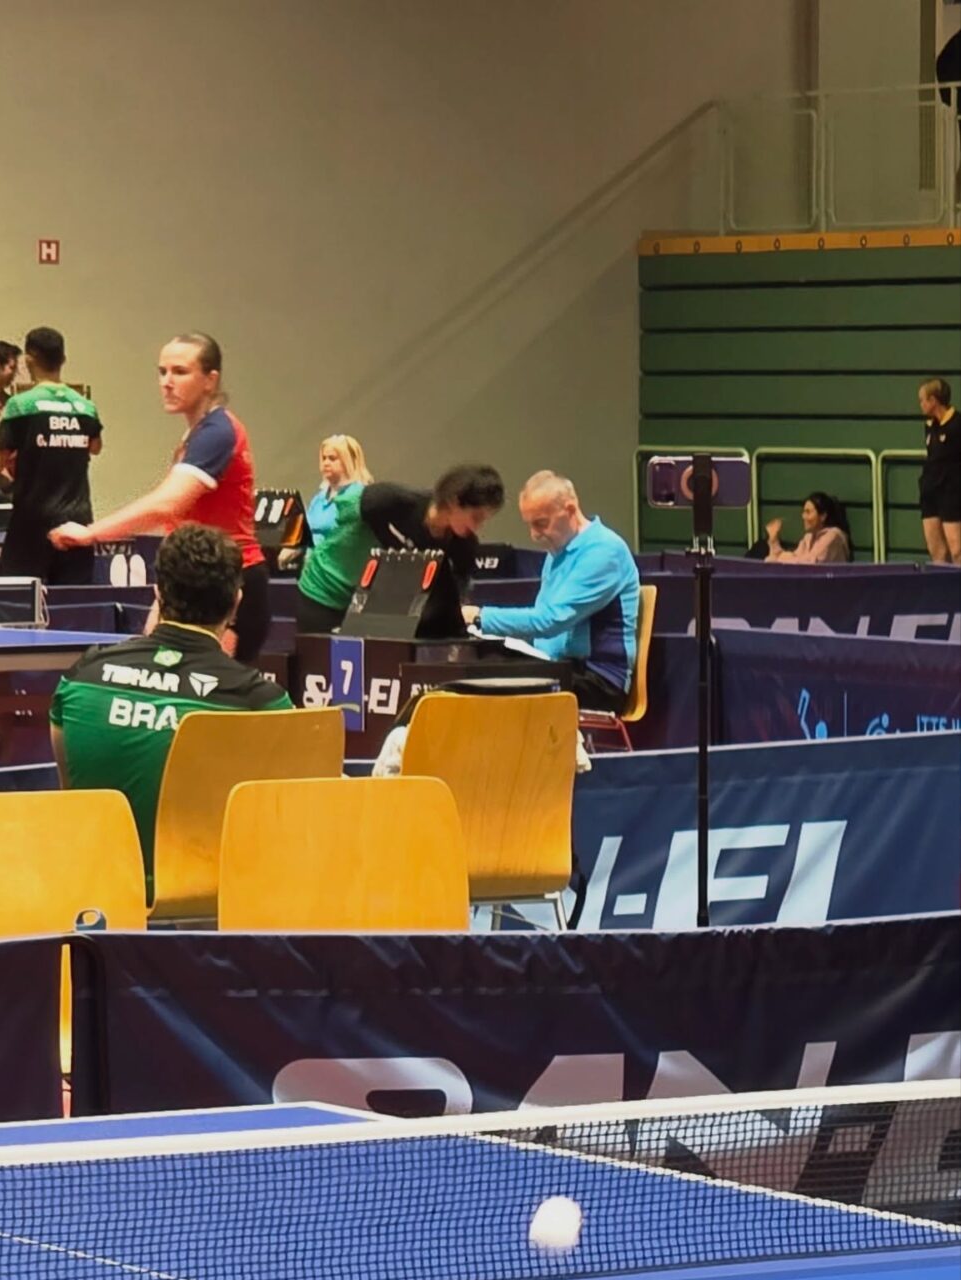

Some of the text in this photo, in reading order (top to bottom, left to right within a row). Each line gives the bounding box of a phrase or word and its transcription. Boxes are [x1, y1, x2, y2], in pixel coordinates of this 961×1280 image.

[41, 242, 57, 260] H
[48, 416, 80, 430] BRA
[302, 673, 401, 716] S-EI
[340, 659, 354, 696] 7
[108, 696, 180, 731] BRA
